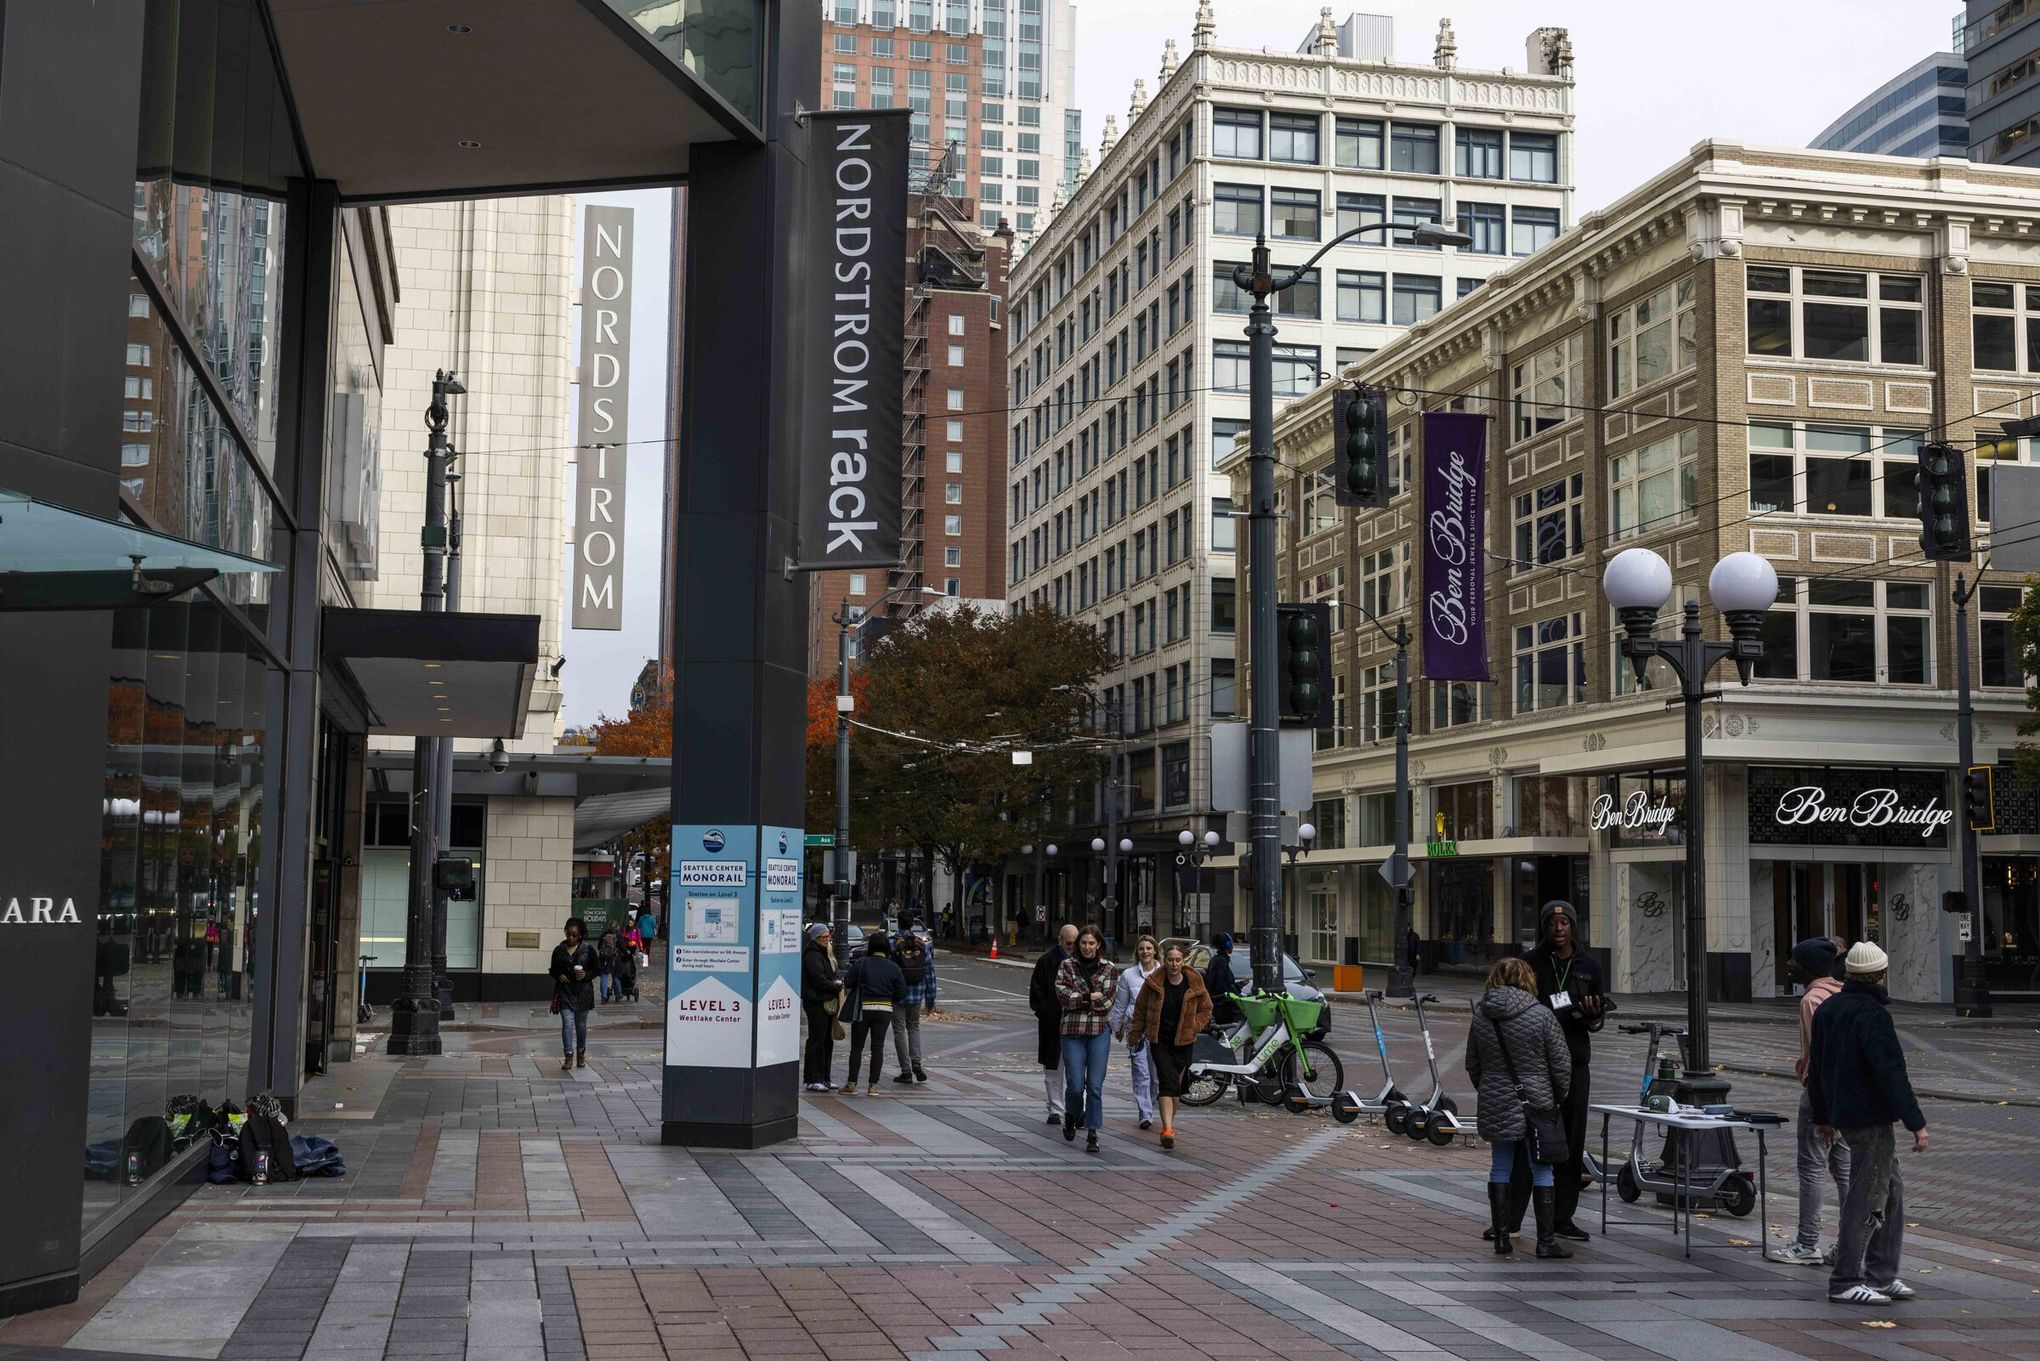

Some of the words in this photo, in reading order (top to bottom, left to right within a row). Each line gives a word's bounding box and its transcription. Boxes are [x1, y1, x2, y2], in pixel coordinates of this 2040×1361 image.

[832, 123, 872, 412] NORDSTROM
[581, 223, 624, 610] NORDSTROM
[826, 428, 878, 554] rack
[1430, 451, 1476, 566] Bridge
[1430, 568, 1468, 645] Ben
[1590, 794, 1624, 830] Ben
[1623, 790, 1676, 836] Bridge
[1776, 786, 1848, 825] Ben
[1849, 788, 1952, 838] Bridge
[1425, 840, 1456, 856] ROLEX
[682, 874, 743, 882] MONORAIL
[768, 875, 796, 886] MONORAIL
[0, 897, 82, 923] ARA
[680, 1000, 726, 1012] LEVEL
[732, 1001, 740, 1011] 3
[768, 999, 786, 1010] LEVEL
[787, 998, 791, 1008] 3
[1257, 1039, 1280, 1062] Lime
